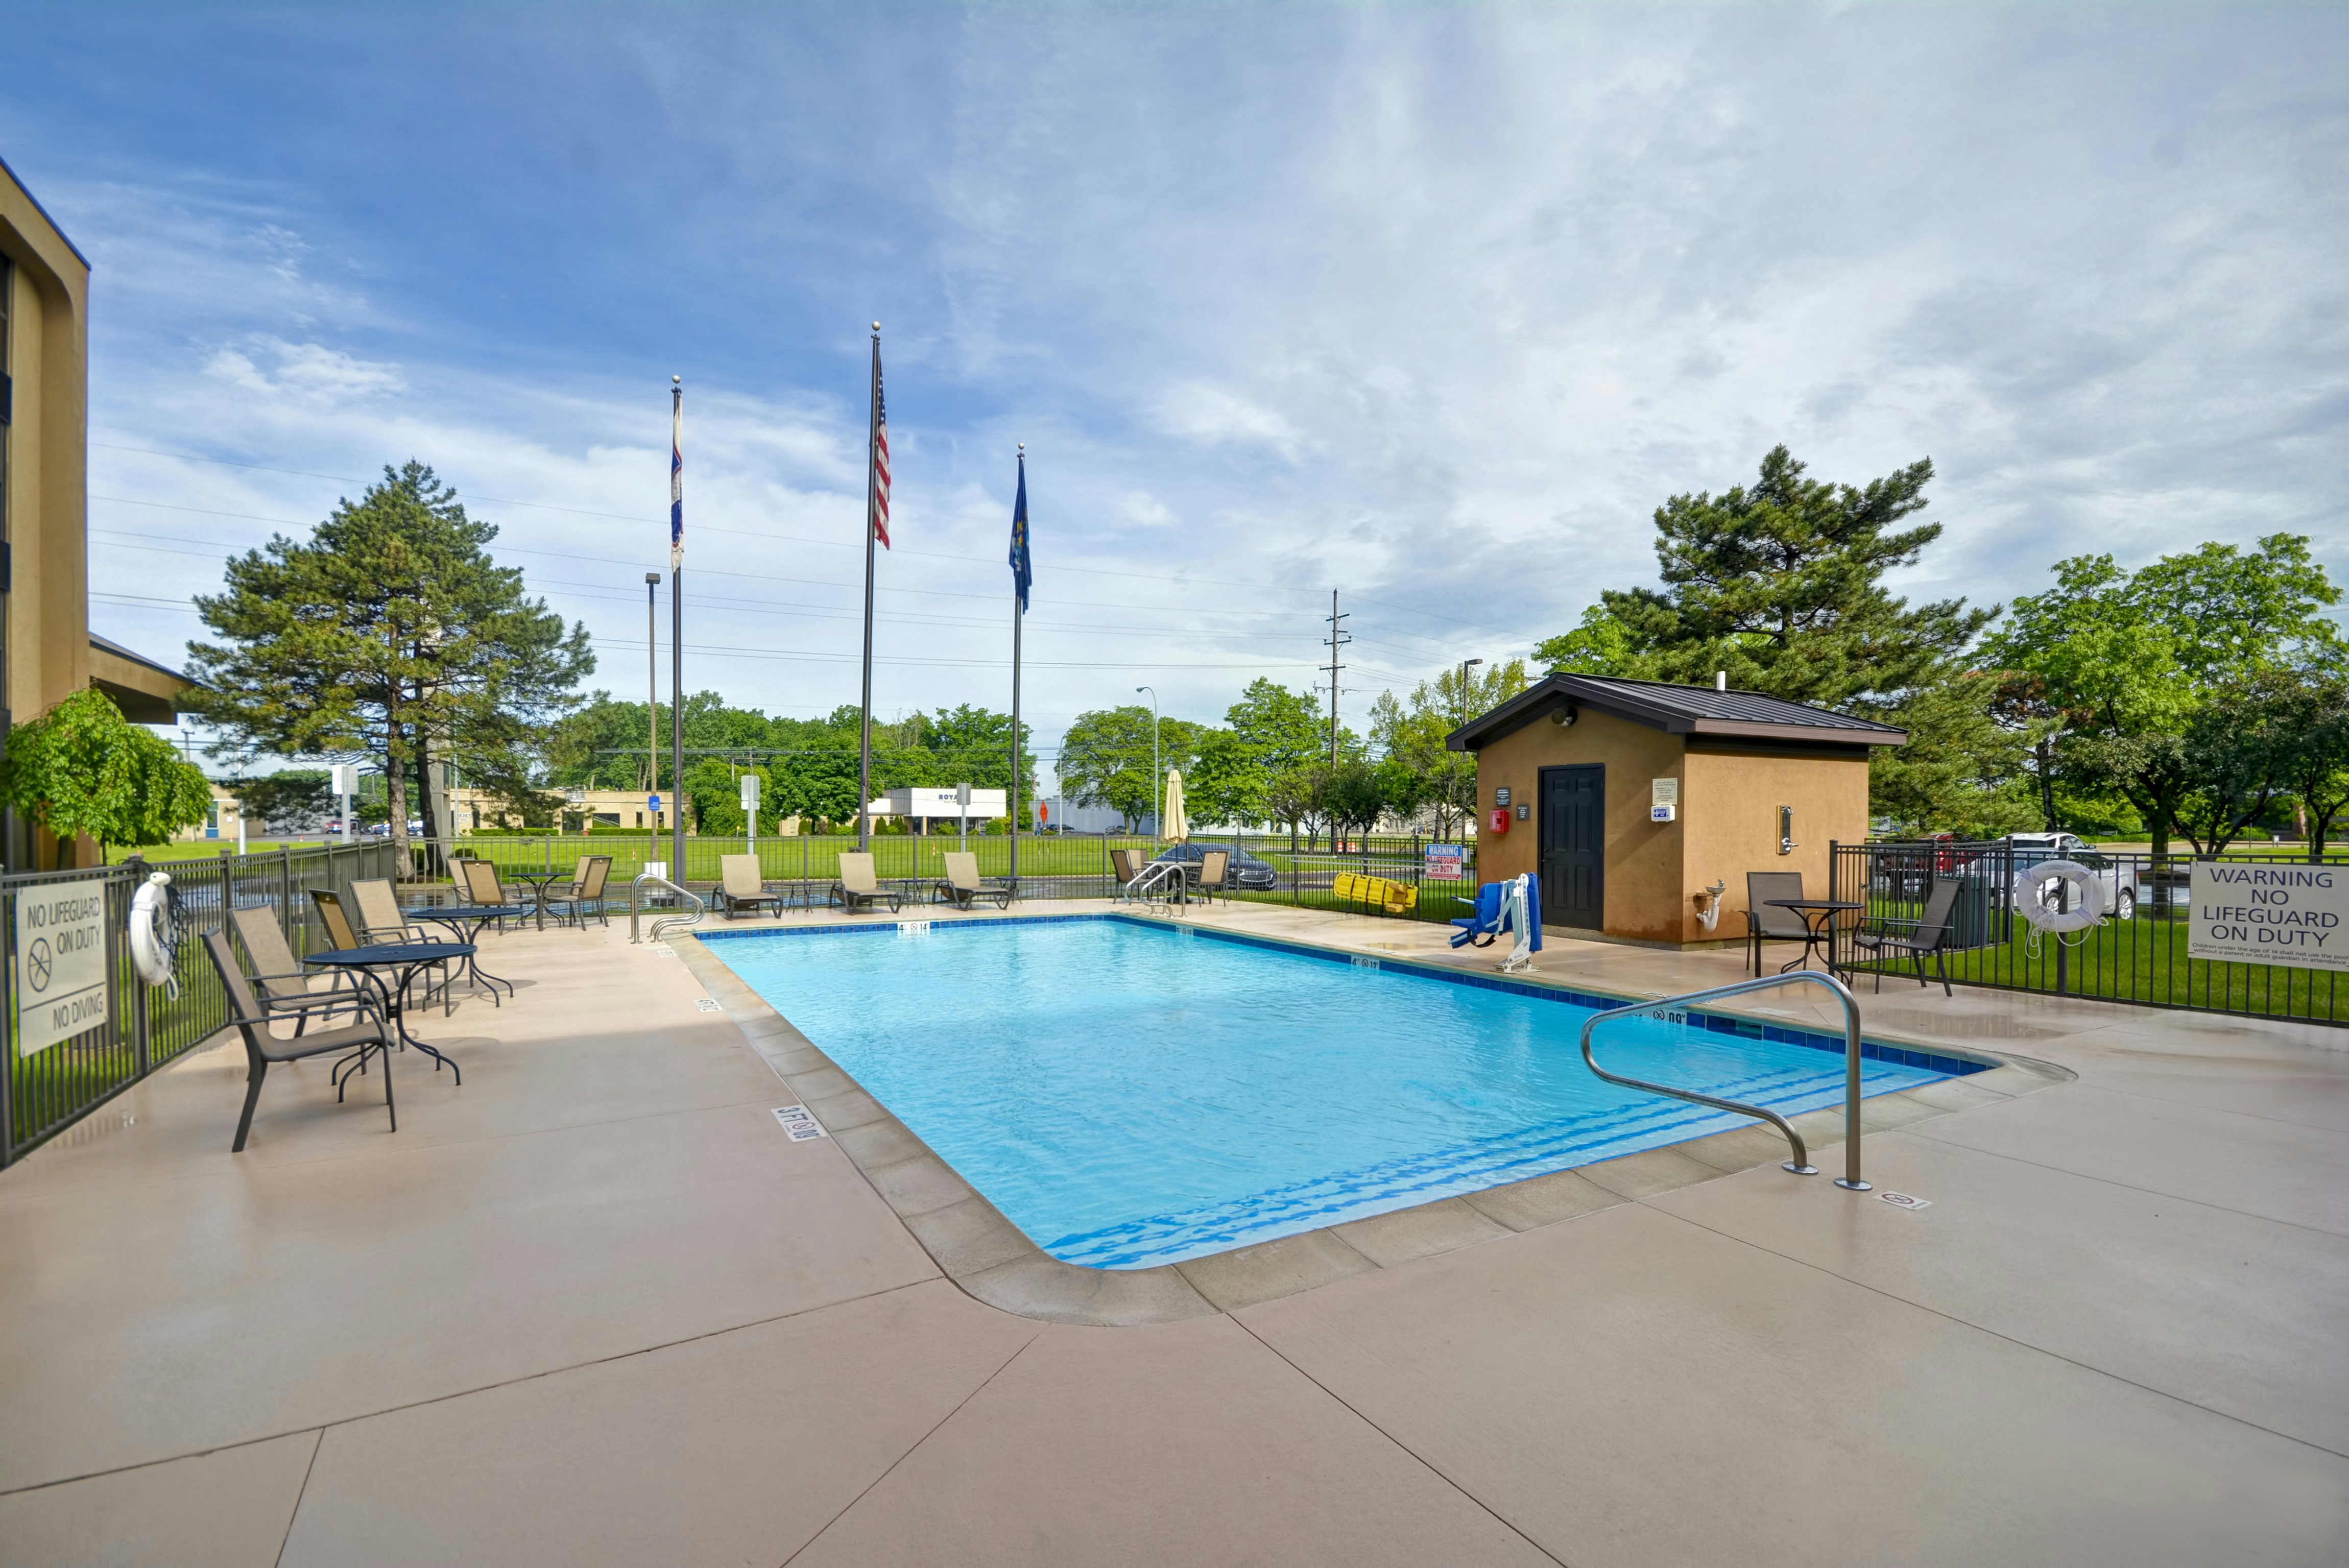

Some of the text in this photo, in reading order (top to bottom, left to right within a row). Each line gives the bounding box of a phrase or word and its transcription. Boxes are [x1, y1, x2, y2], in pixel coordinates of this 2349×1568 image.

[1428, 845, 1459, 856] WARNING
[1434, 856, 1460, 864] LIFEGUARD
[1440, 865, 1453, 873] DUTY
[2210, 868, 2333, 888] WARNING
[2251, 889, 2289, 905] NO
[28, 897, 101, 929] NO LIFEGUARD
[2203, 905, 2339, 928] LIFEGUARD
[57, 924, 102, 955] ON DUTY
[2211, 925, 2330, 947] ON DUTY
[2310, 957, 2346, 966] attendance
[53, 992, 104, 1031] NO DIVING
